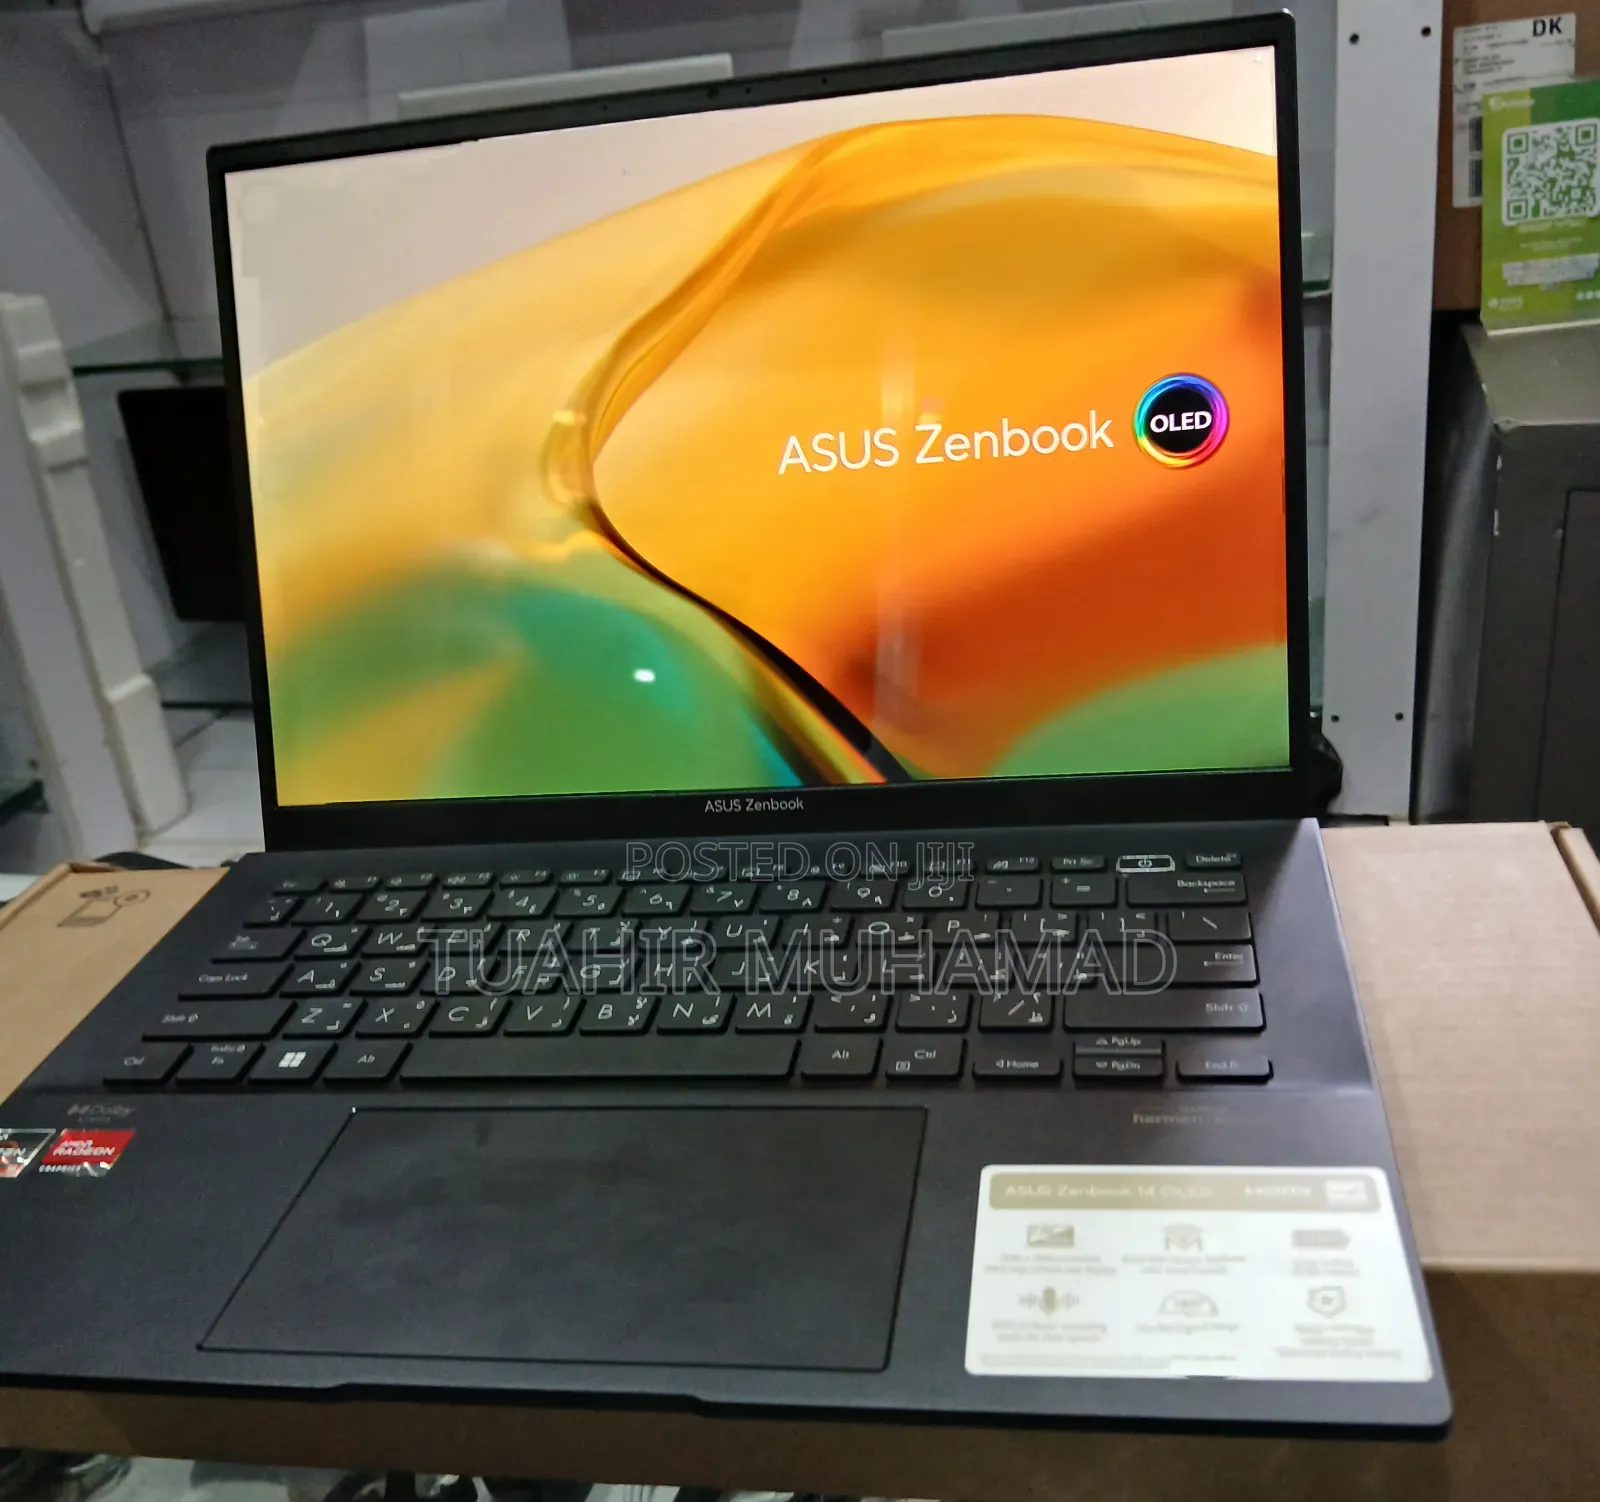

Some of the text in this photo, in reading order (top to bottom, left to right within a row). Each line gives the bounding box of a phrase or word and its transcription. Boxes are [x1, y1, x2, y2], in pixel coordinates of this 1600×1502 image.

[1532, 17, 1563, 37] DK
[778, 410, 1212, 475] ASUS Zenbook OLED
[704, 797, 804, 813] ASUS Zenbook
[582, 894, 597, 907] 5
[311, 933, 332, 948] Q
[377, 932, 403, 946] W
[516, 930, 531, 942] R
[658, 926, 673, 940] Y
[726, 924, 743, 938] U
[868, 921, 890, 935] O
[946, 919, 960, 933] P
[298, 970, 315, 983] A
[370, 967, 386, 982] S
[437, 967, 456, 981] D
[511, 965, 527, 980] F
[654, 962, 674, 977] H
[731, 961, 746, 976] J
[803, 959, 820, 975] K
[301, 1007, 323, 1024] Z
[375, 1007, 395, 1023] X
[448, 1006, 470, 1022] C
[526, 1005, 543, 1021] V
[597, 1004, 613, 1020] B
[672, 1003, 694, 1018] N
[747, 1002, 772, 1018] M
[1006, 1060, 1039, 1069] Home
